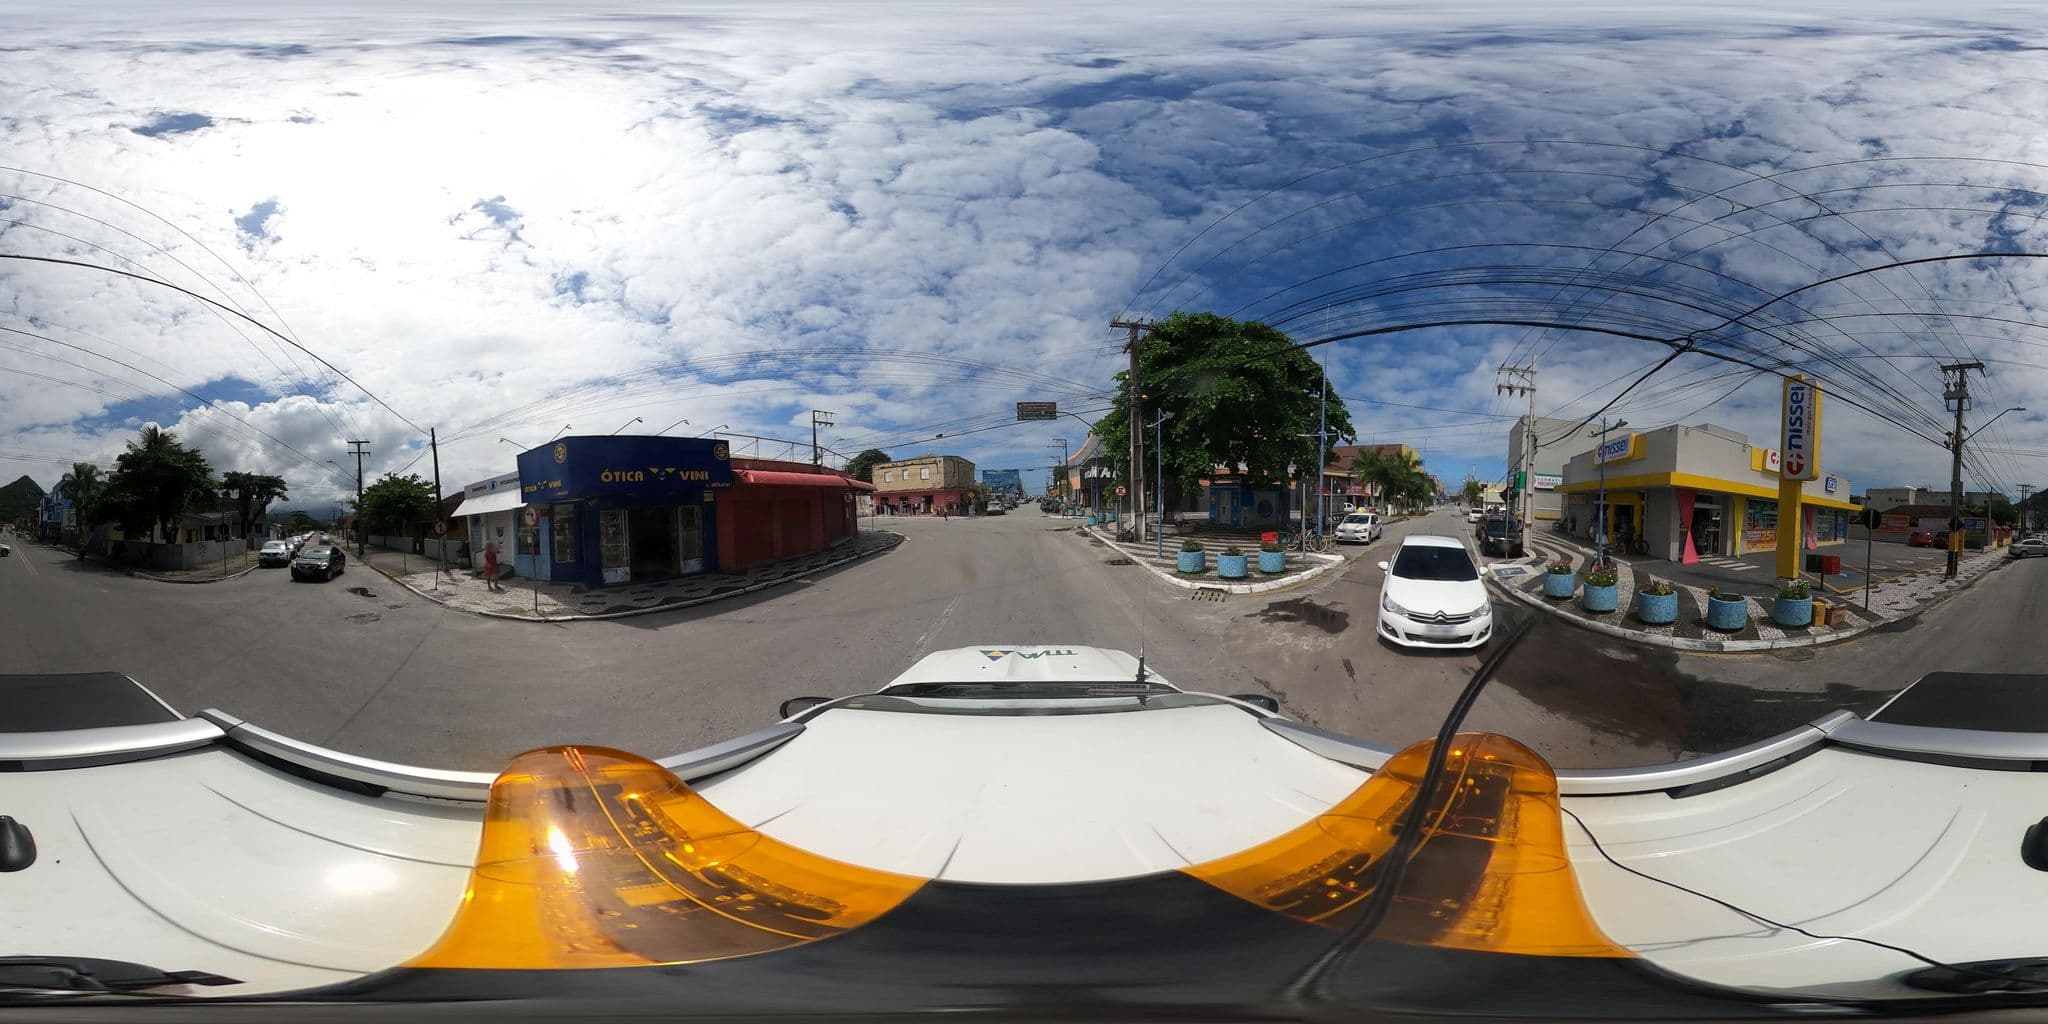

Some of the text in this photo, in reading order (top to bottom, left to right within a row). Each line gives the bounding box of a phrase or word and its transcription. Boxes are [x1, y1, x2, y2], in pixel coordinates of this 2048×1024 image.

[1788, 386, 1806, 450] nissei
[600, 468, 709, 482] ÓTICA VINI
